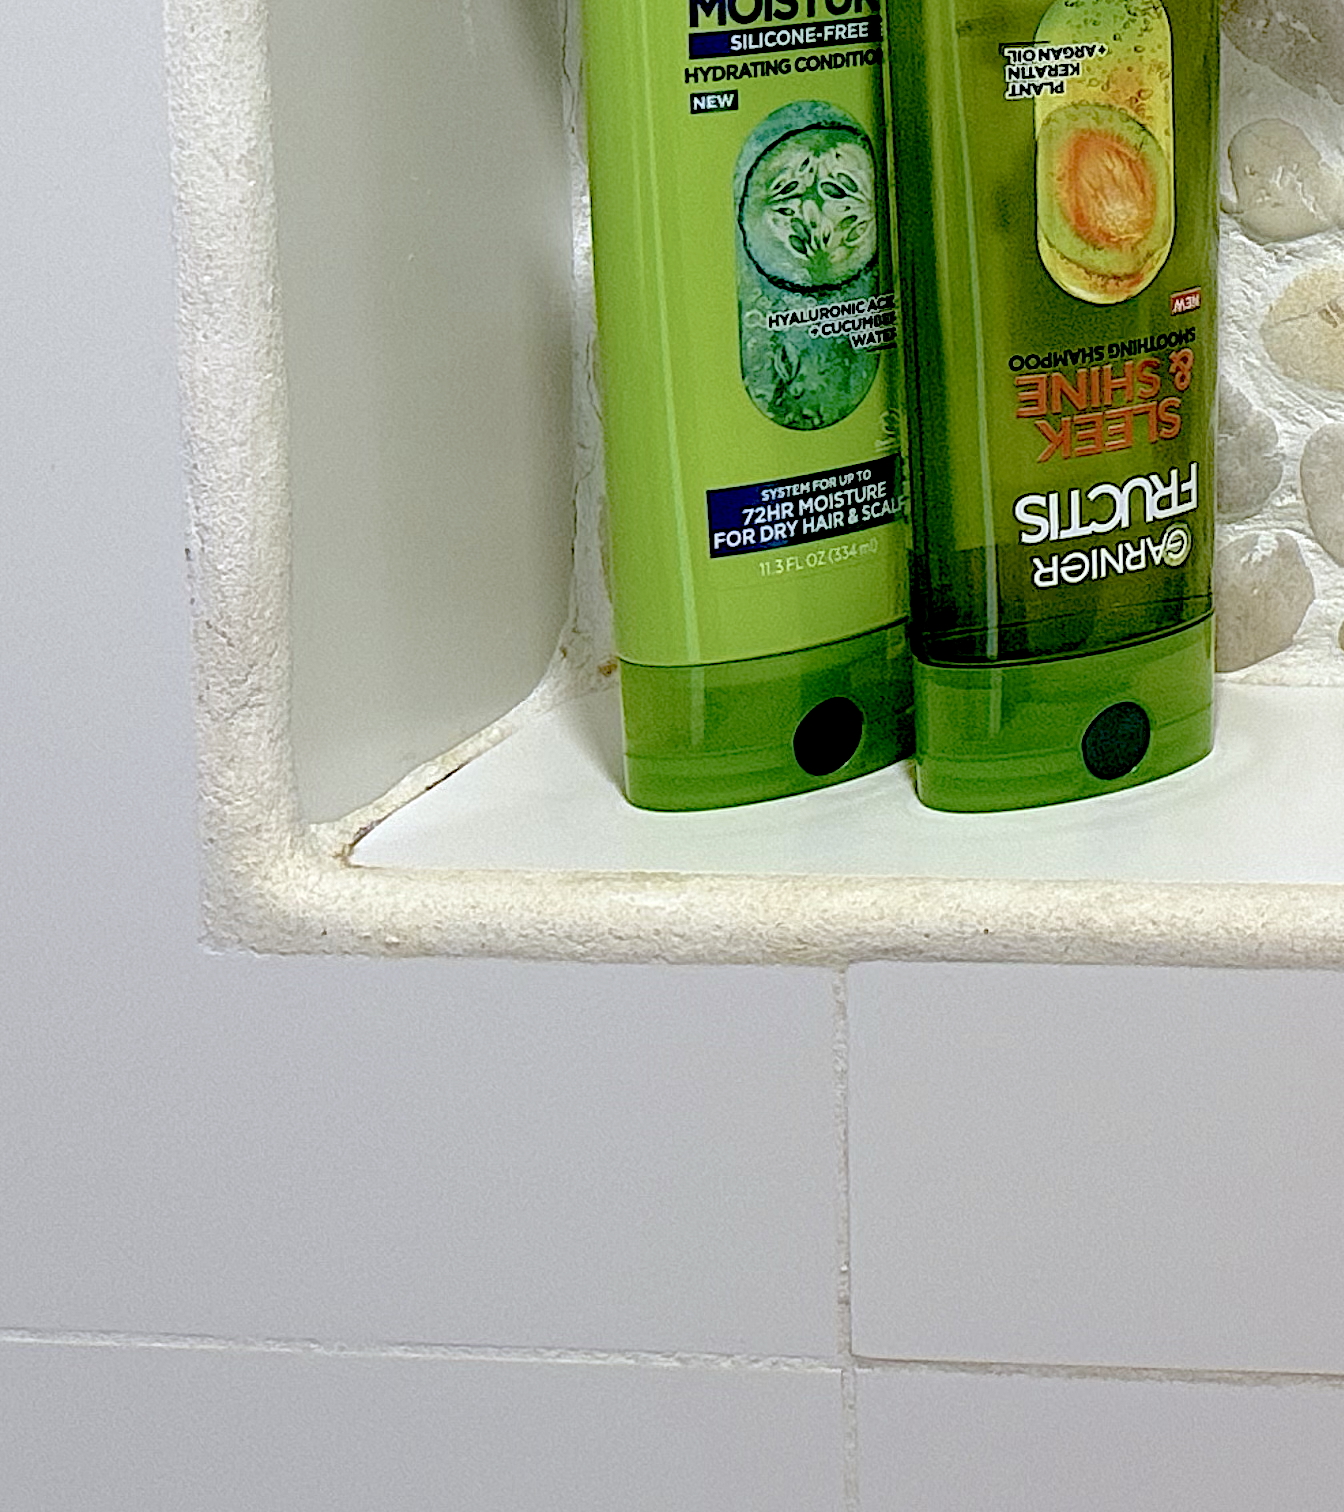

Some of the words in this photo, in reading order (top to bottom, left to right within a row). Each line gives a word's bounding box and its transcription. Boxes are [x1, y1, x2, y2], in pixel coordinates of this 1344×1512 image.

[730, 21, 869, 51] SILICONE-FREE
[684, 58, 792, 84] HYDRATING
[794, 48, 883, 73] CONDITIO
[1007, 50, 1036, 63] OIL
[1038, 45, 1097, 62] ARGAN
[1008, 63, 1080, 80] KERATIN
[692, 93, 735, 111] NEW
[1008, 81, 1065, 97] PLANT
[768, 300, 866, 329] HYALURONIC
[866, 295, 895, 313] AC
[1172, 293, 1200, 314] NEW
[821, 311, 896, 336] CUCUMB
[1009, 346, 1105, 372] SHAMPOO
[1107, 327, 1196, 359] SMOOTHING
[1168, 348, 1195, 392] &
[1014, 358, 1161, 418] SHINE
[1034, 397, 1182, 463] SLEEK
[761, 482, 811, 502] SYSTEM
[812, 477, 837, 494] FOR
[839, 472, 855, 487] UP
[856, 469, 872, 483] TO
[742, 501, 795, 527] 72HR
[798, 481, 888, 515] MOISTURE
[1014, 462, 1198, 544] FRUCTIS
[714, 529, 756, 550] FOR
[759, 519, 799, 544] DRY
[802, 510, 845, 535] HAIR
[847, 507, 859, 525] &
[786, 556, 804, 572] FL
[805, 550, 827, 568] OZ
[1031, 525, 1189, 588] GARNIER
